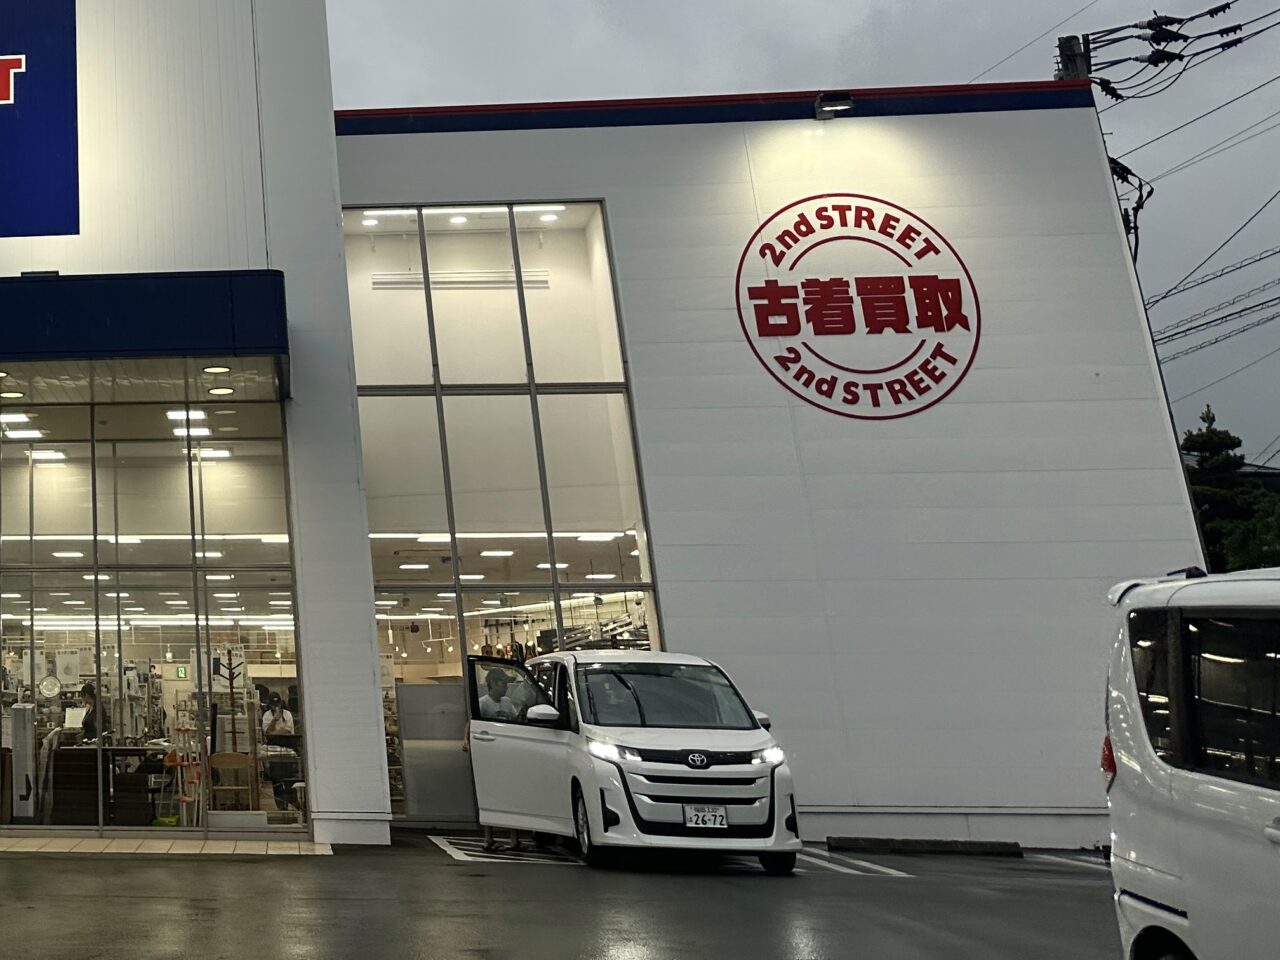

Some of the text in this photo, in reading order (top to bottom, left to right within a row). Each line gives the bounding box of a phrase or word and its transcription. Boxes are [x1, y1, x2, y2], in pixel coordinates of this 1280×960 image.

[759, 204, 942, 267] 2nd STREET
[747, 275, 970, 337] 古着買取
[773, 342, 958, 408] 2nd STREET
[694, 813, 726, 826] 26-72
